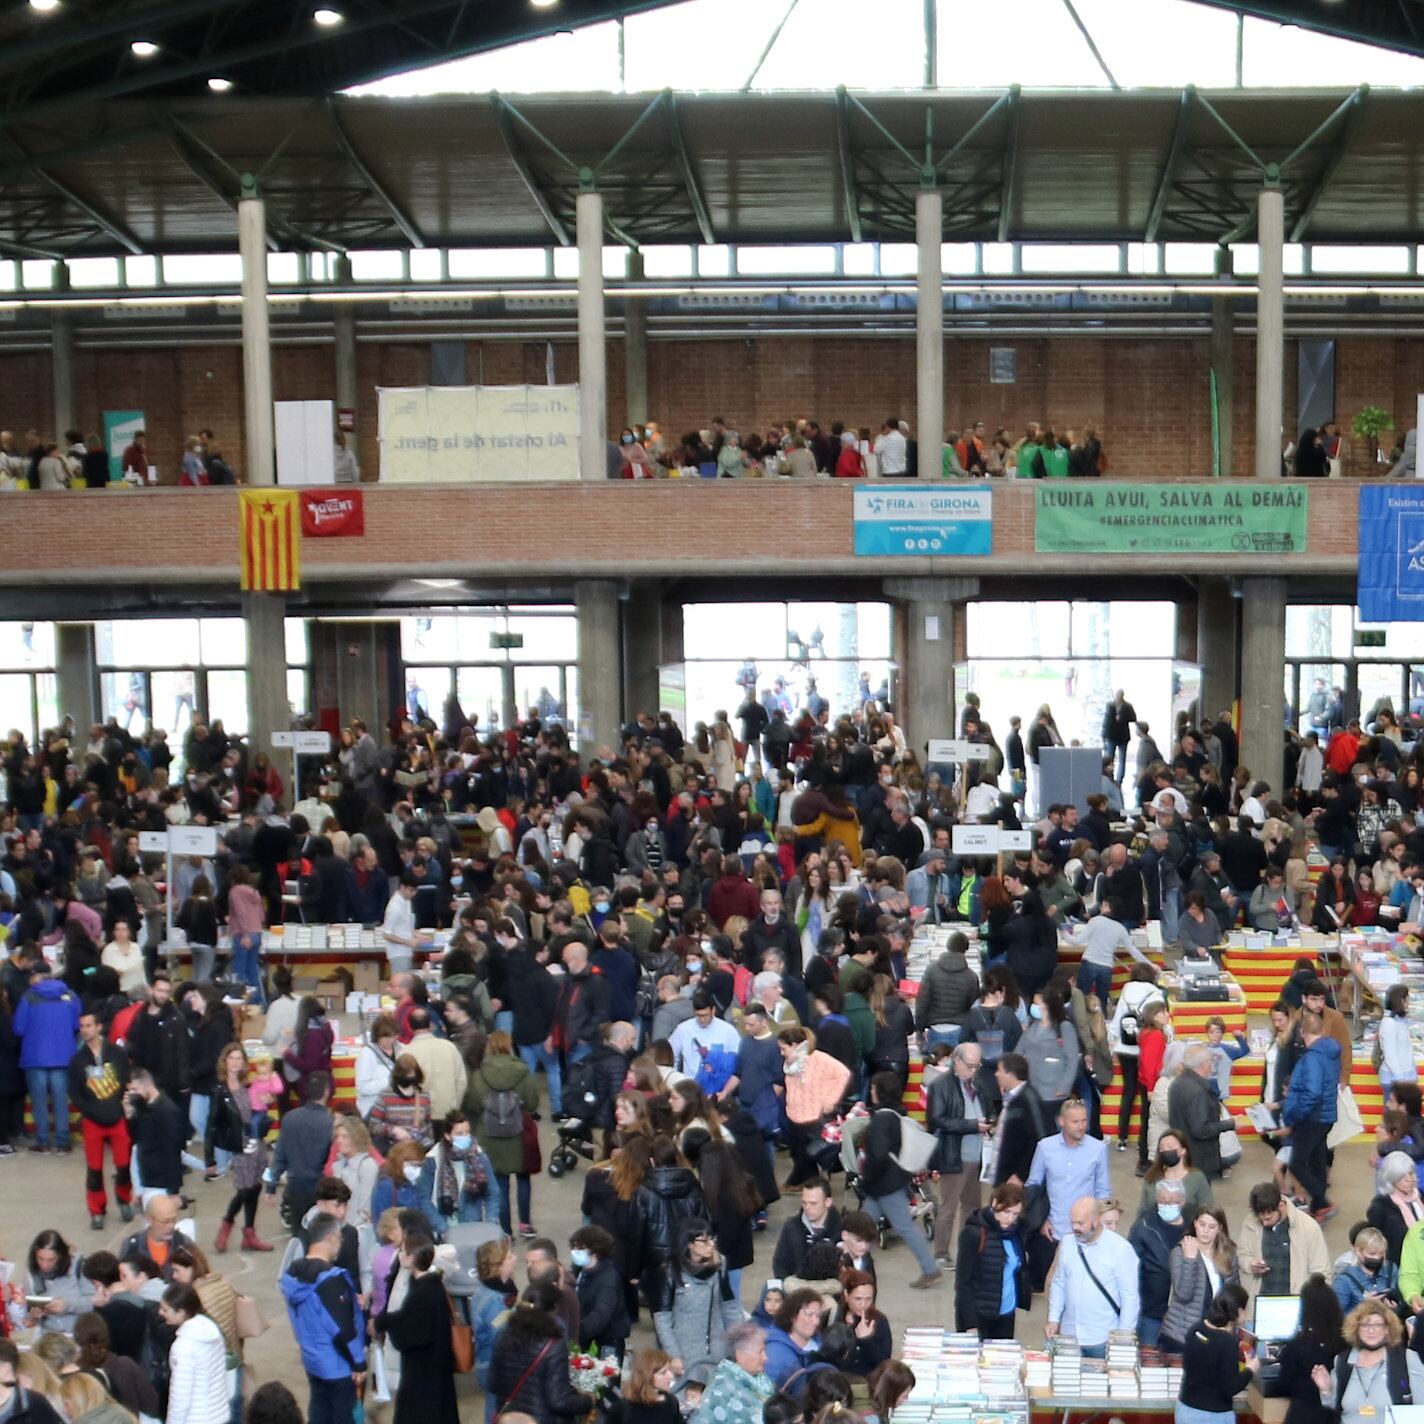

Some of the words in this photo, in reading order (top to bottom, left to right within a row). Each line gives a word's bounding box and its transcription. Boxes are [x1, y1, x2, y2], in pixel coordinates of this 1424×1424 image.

[886, 498, 915, 509] FIRA
[930, 498, 980, 509] GIRONA
[1041, 490, 1095, 507] LLUITA
[1105, 490, 1150, 510] AVUI,
[1159, 490, 1213, 507] SALVA
[1223, 490, 1243, 507] AL
[1251, 486, 1302, 507] DEMÀ!
[1388, 497, 1418, 508] Existim
